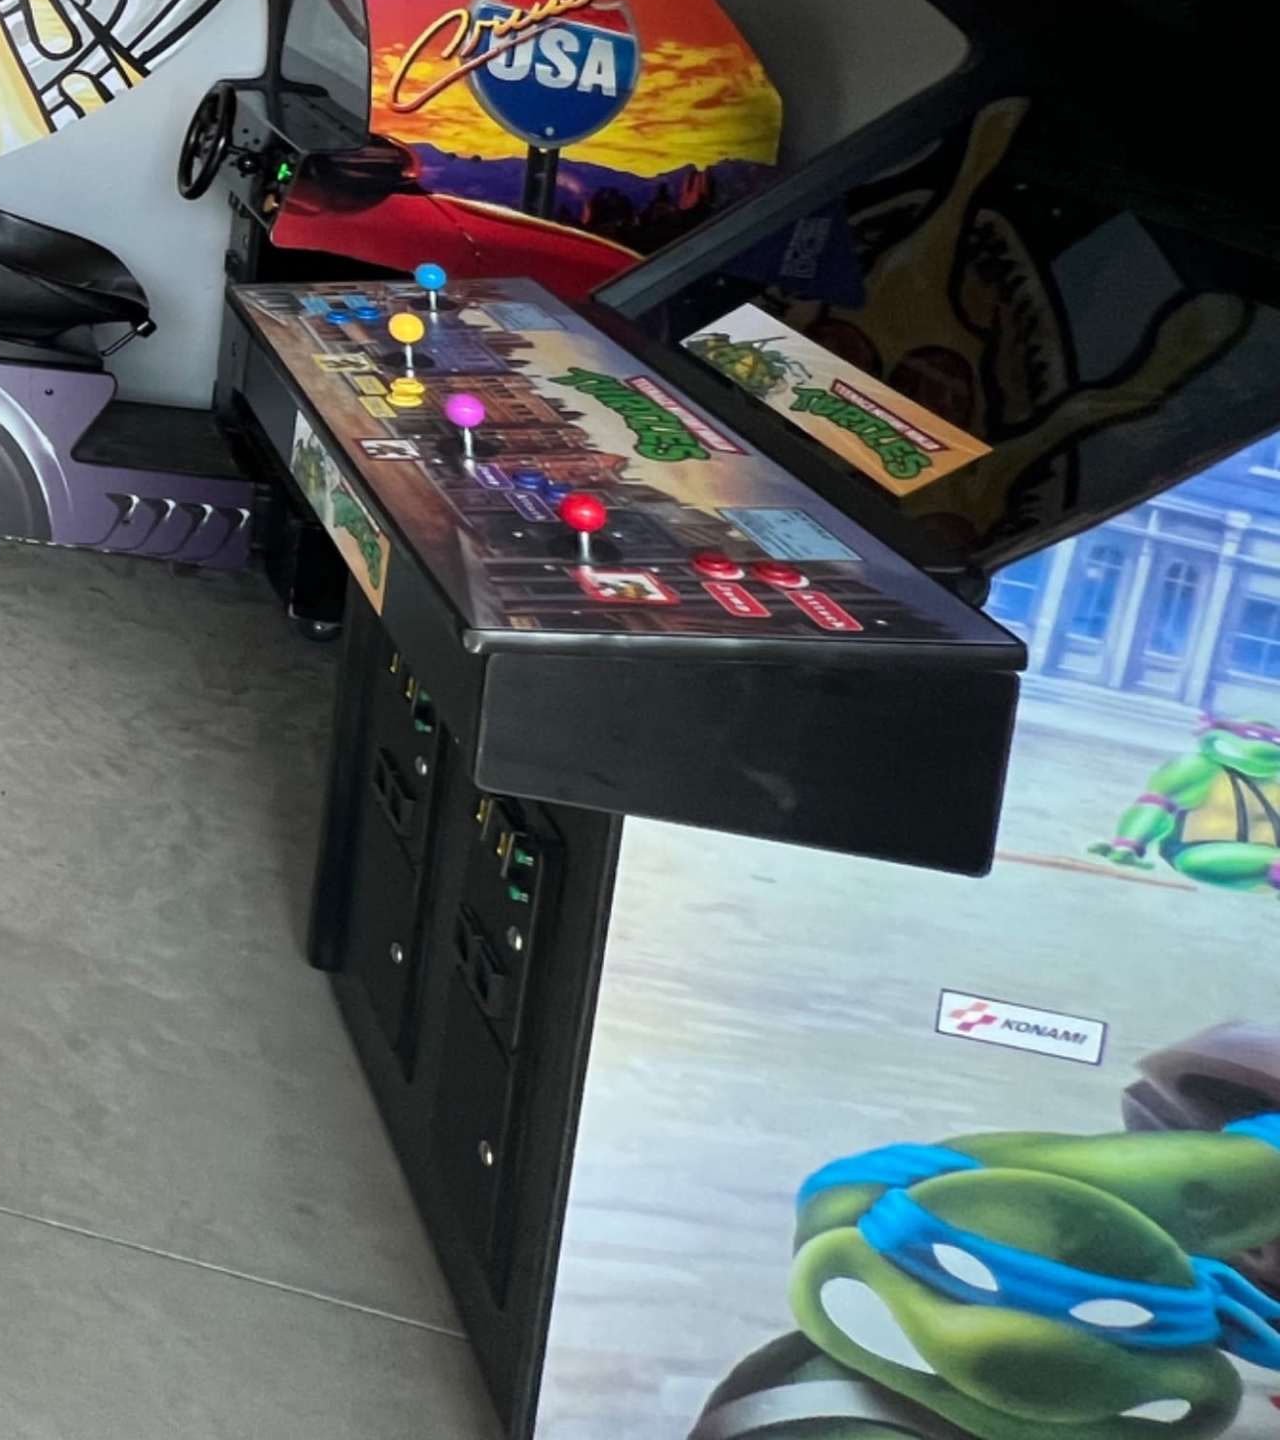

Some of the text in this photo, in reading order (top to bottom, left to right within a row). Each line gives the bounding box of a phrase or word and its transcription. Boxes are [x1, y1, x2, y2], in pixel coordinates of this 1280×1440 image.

[486, 16, 618, 97] USA
[547, 366, 711, 462] TURTLES
[790, 386, 933, 480] TURTLES
[1000, 1018, 1089, 1045] KONAMI
